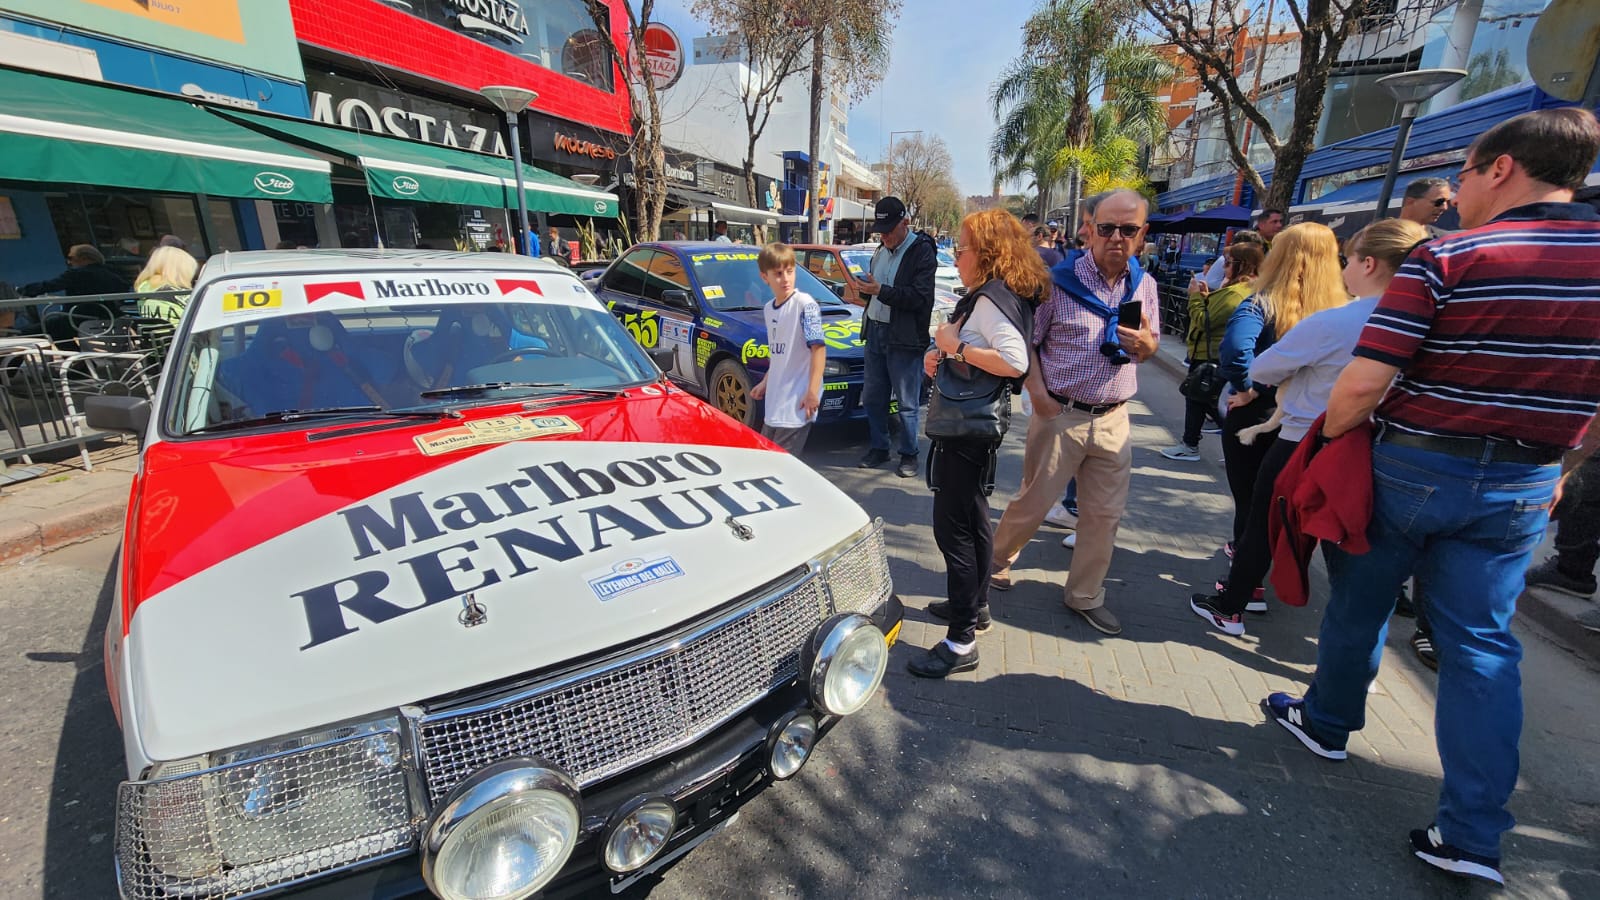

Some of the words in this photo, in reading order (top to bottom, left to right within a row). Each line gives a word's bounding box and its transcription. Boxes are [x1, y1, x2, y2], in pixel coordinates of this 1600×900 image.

[631, 56, 676, 72] MSTAZA
[371, 278, 490, 299] Marlboro
[233, 291, 271, 309] 10
[429, 434, 476, 448] Marlboro
[336, 451, 722, 562] Marlboro
[289, 475, 802, 652] RENAULT
[595, 575, 641, 596] LEYENDAS
[639, 569, 657, 582] DEL
[652, 561, 678, 578] RALLY
